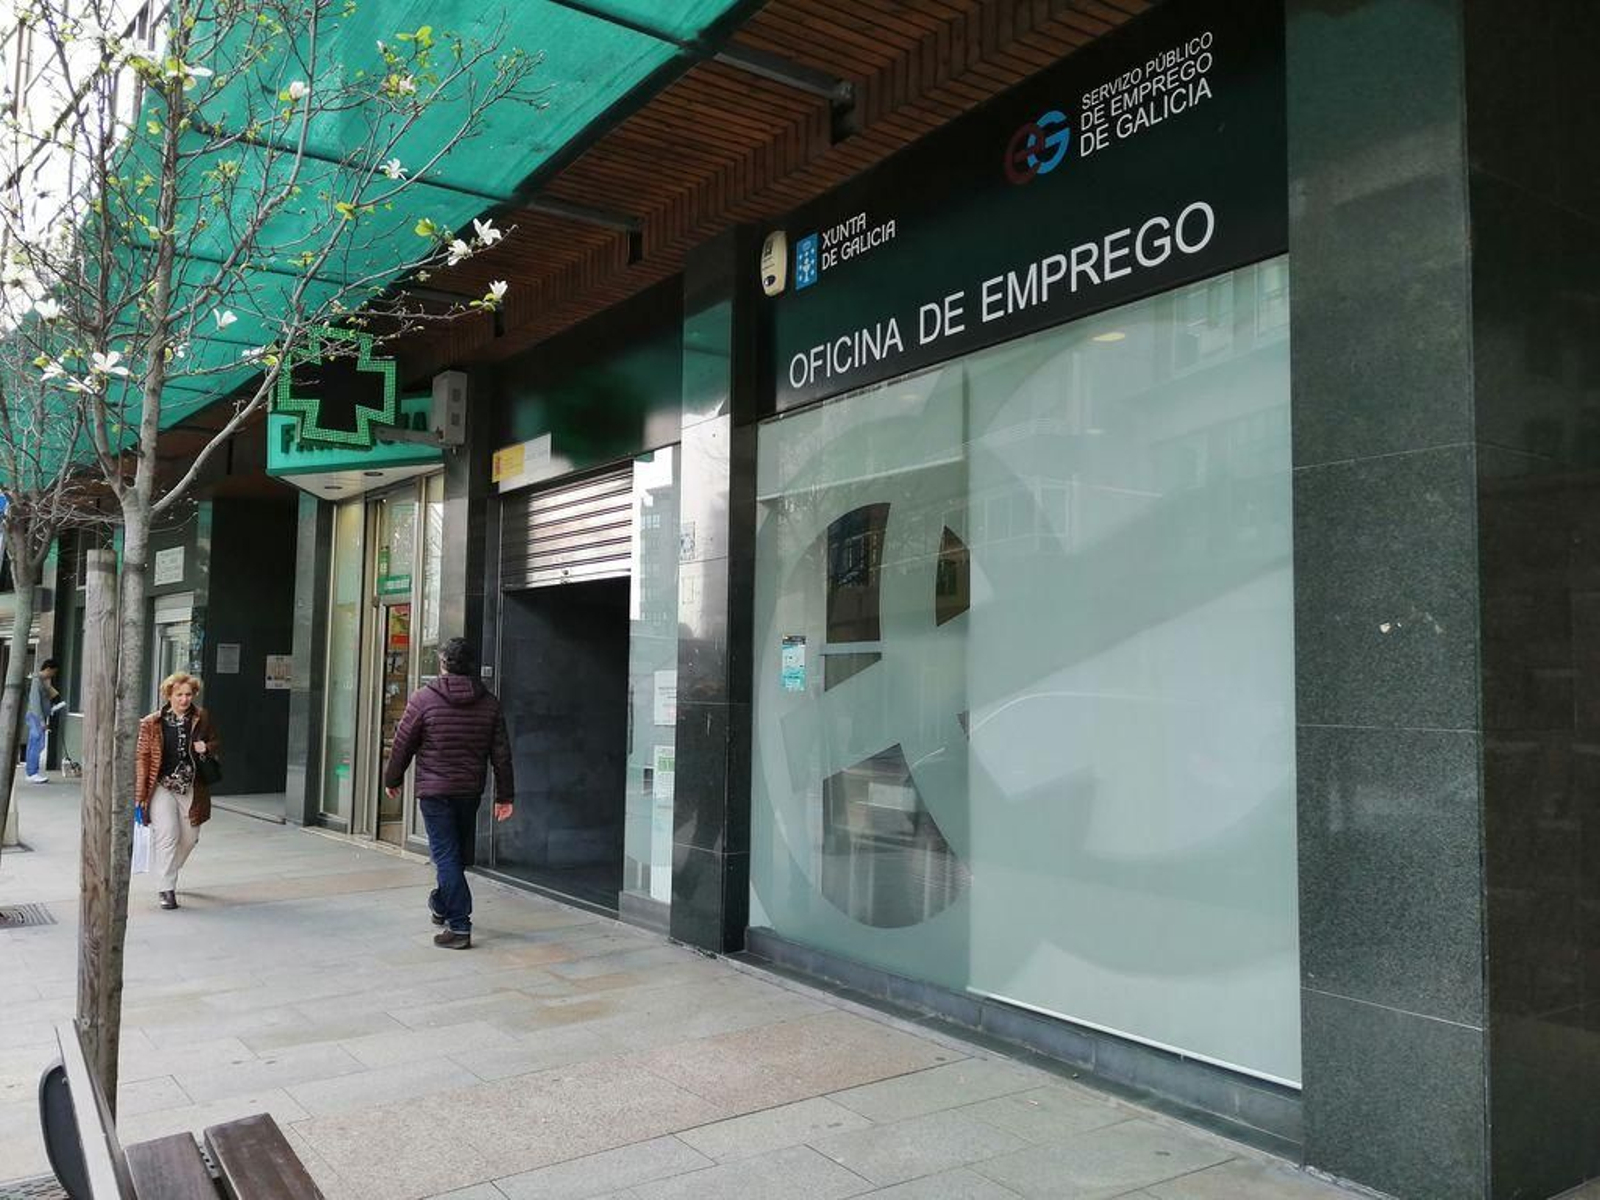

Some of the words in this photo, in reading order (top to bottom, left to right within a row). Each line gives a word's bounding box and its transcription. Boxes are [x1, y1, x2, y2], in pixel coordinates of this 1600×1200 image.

[1080, 103, 1105, 131] DE
[1110, 52, 1213, 116] EMPREGO
[1081, 68, 1142, 110] SERVIZO
[1145, 31, 1213, 78] PÚBLICO
[1080, 123, 1110, 157] DE
[1116, 77, 1213, 139] GALICIA
[821, 249, 838, 271] DE
[841, 219, 896, 261] GALICIA
[822, 212, 867, 250] XUNTA
[789, 317, 904, 389] OFICINA
[918, 290, 966, 345] DE
[981, 201, 1216, 324] EMPREGO
